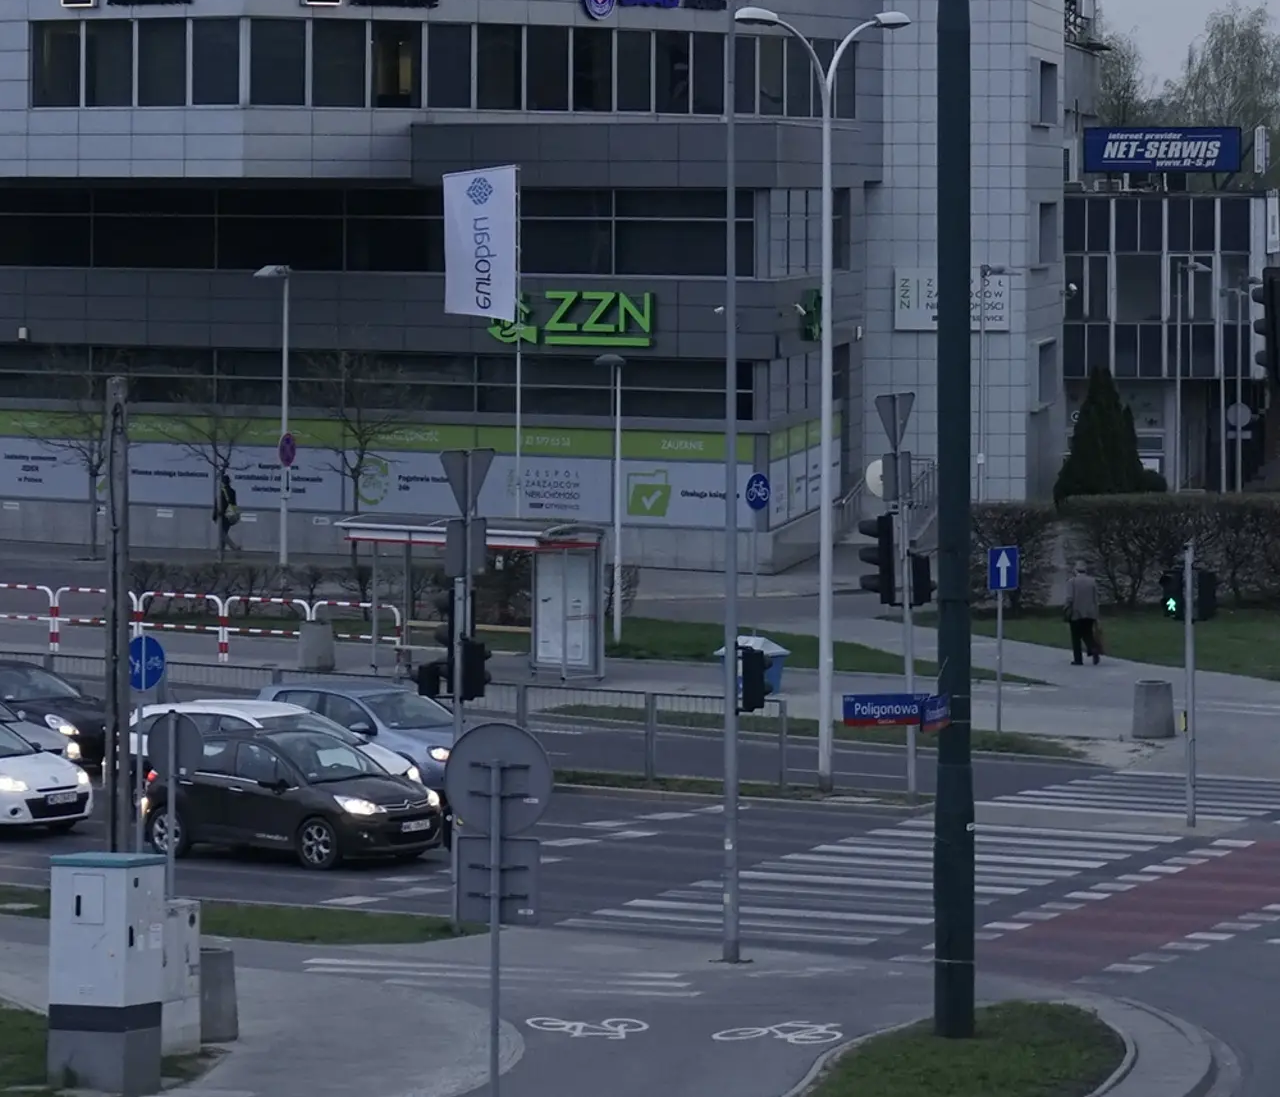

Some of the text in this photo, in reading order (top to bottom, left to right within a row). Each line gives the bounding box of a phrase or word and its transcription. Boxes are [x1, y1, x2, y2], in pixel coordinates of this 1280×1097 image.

[1107, 132, 1183, 141] internet provider
[1103, 140, 1221, 159] NET-SERWIS
[544, 290, 652, 333] ZZN
[854, 702, 919, 719] Poligonowa
